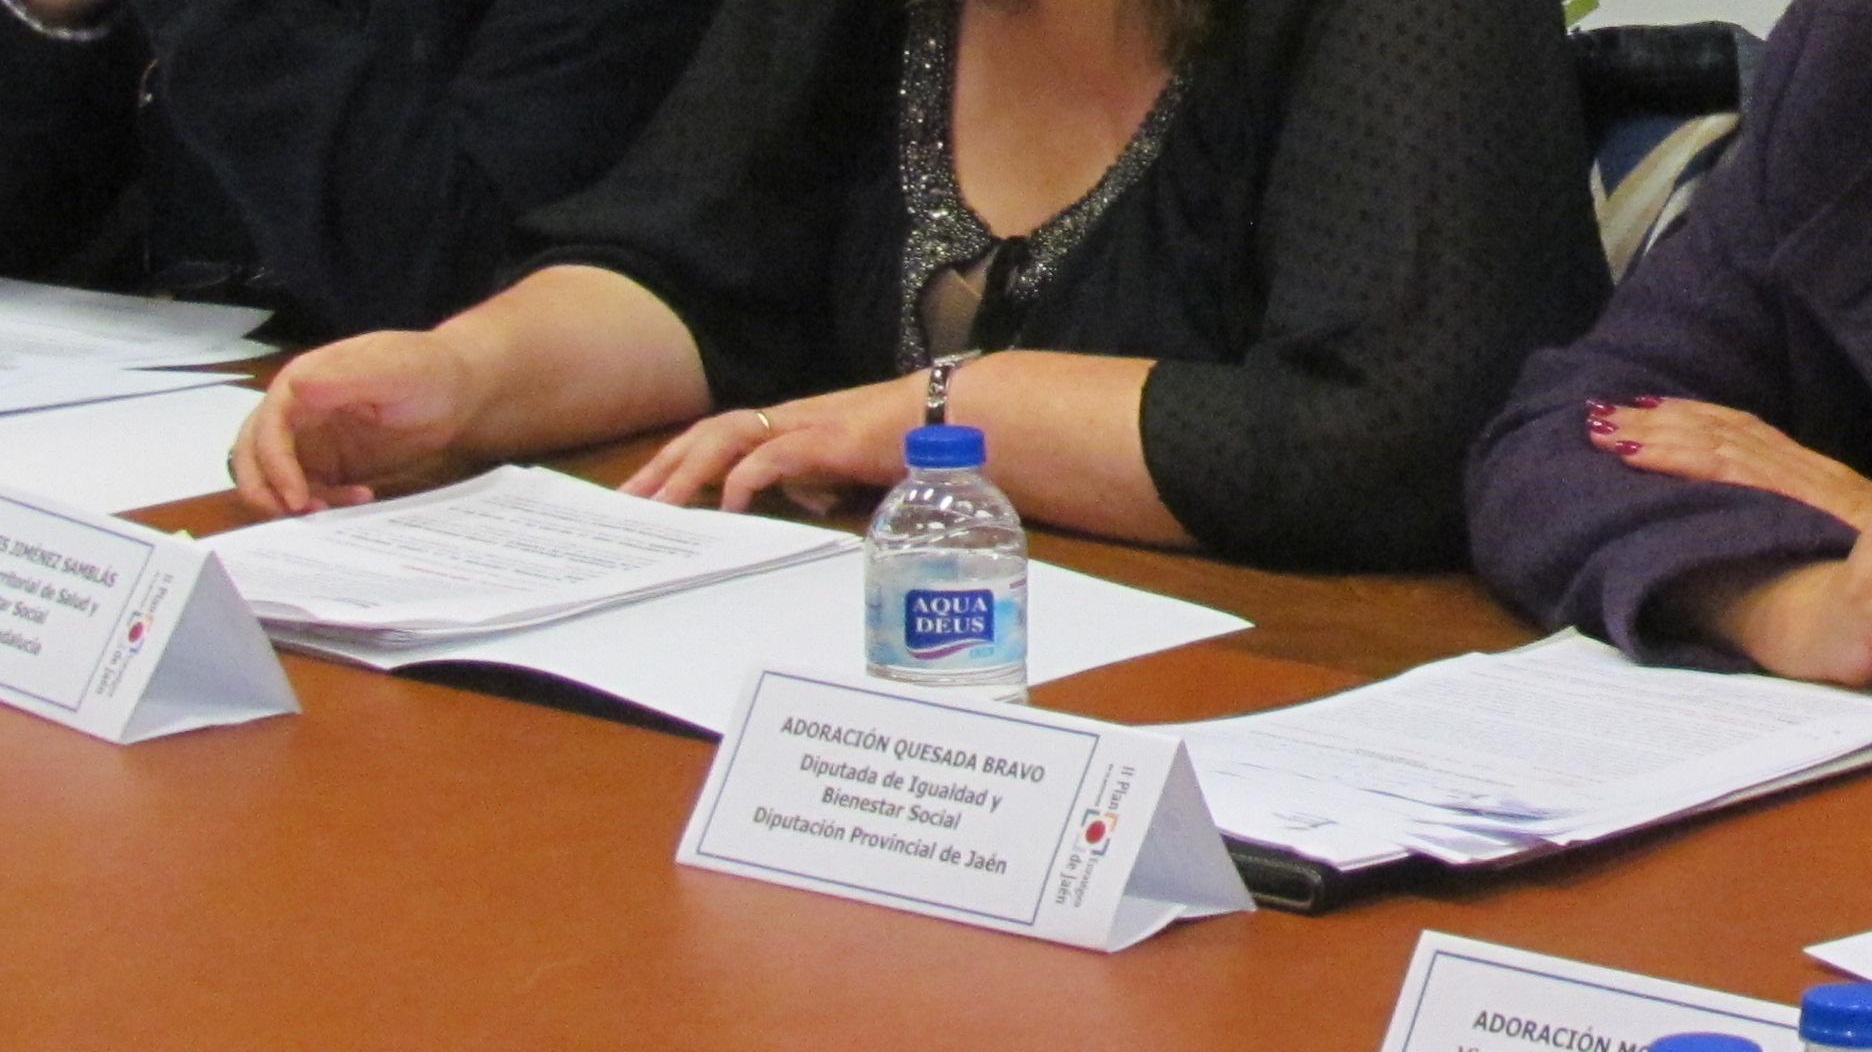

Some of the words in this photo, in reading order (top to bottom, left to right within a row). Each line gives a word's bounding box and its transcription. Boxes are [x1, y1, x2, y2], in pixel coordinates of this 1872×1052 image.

[911, 597, 988, 615] AQUA
[915, 616, 985, 633] DEUS
[781, 716, 890, 752] ADORACIÓN
[893, 739, 979, 771] QUESADA
[983, 756, 1045, 784] BRAVO
[800, 753, 878, 789] Diputada
[882, 771, 905, 791] de
[907, 775, 987, 809] Igualdad
[988, 792, 1004, 813] y
[821, 787, 903, 818] Bienestar
[907, 801, 960, 831] Social
[753, 805, 845, 841] Diputación
[850, 826, 936, 860] Provincial
[939, 841, 961, 863] de
[965, 847, 1008, 875] Jaén
[1472, 1010, 1611, 1052] ADORACIÓN
